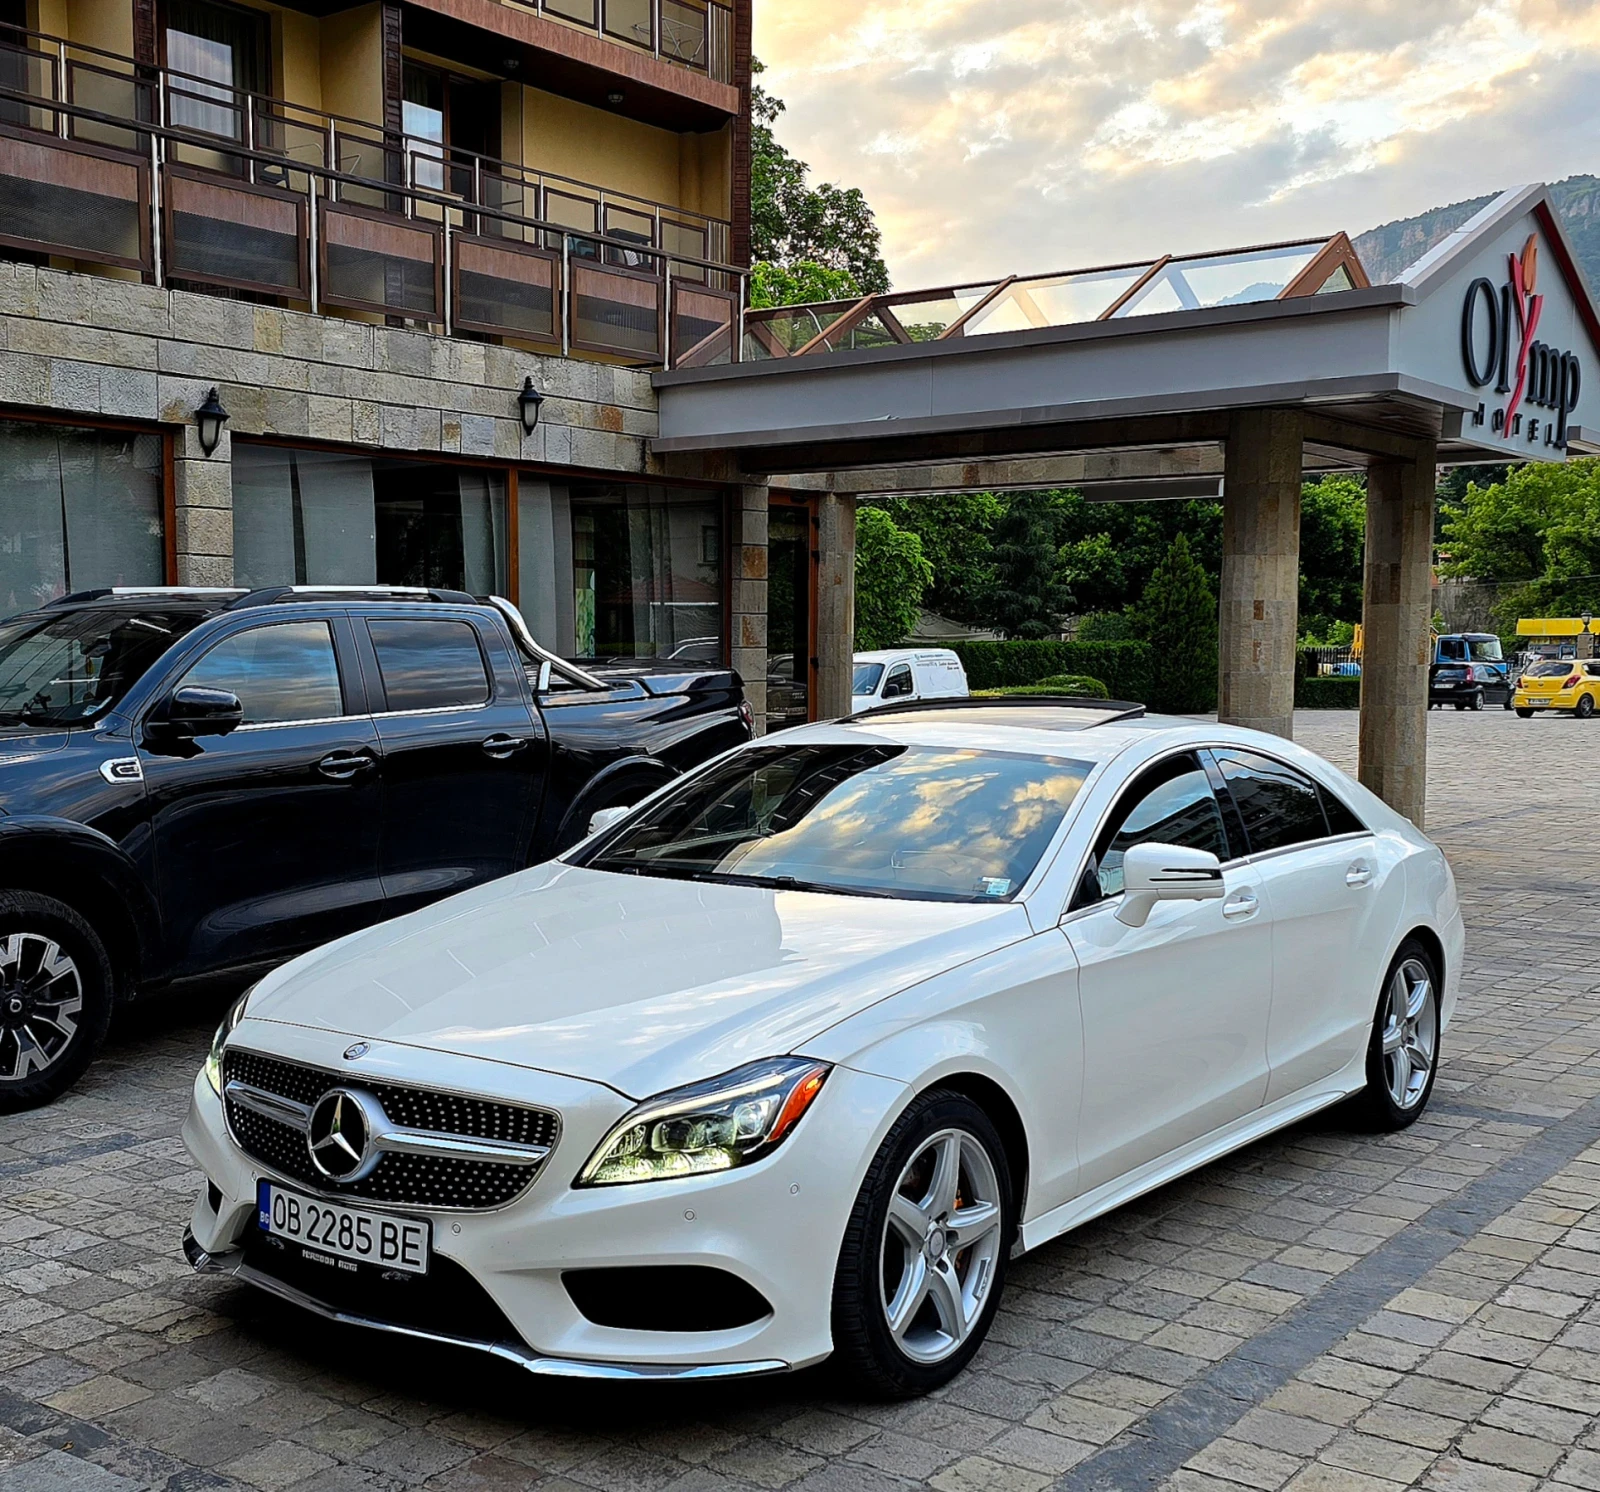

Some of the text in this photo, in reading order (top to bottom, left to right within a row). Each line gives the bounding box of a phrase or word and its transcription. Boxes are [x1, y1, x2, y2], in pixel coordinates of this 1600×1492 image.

[1462, 252, 1581, 449] Olymp
[1473, 402, 1554, 447] HOTEL
[259, 1210, 271, 1225] BG
[273, 1193, 421, 1266] OB 2285 BE
